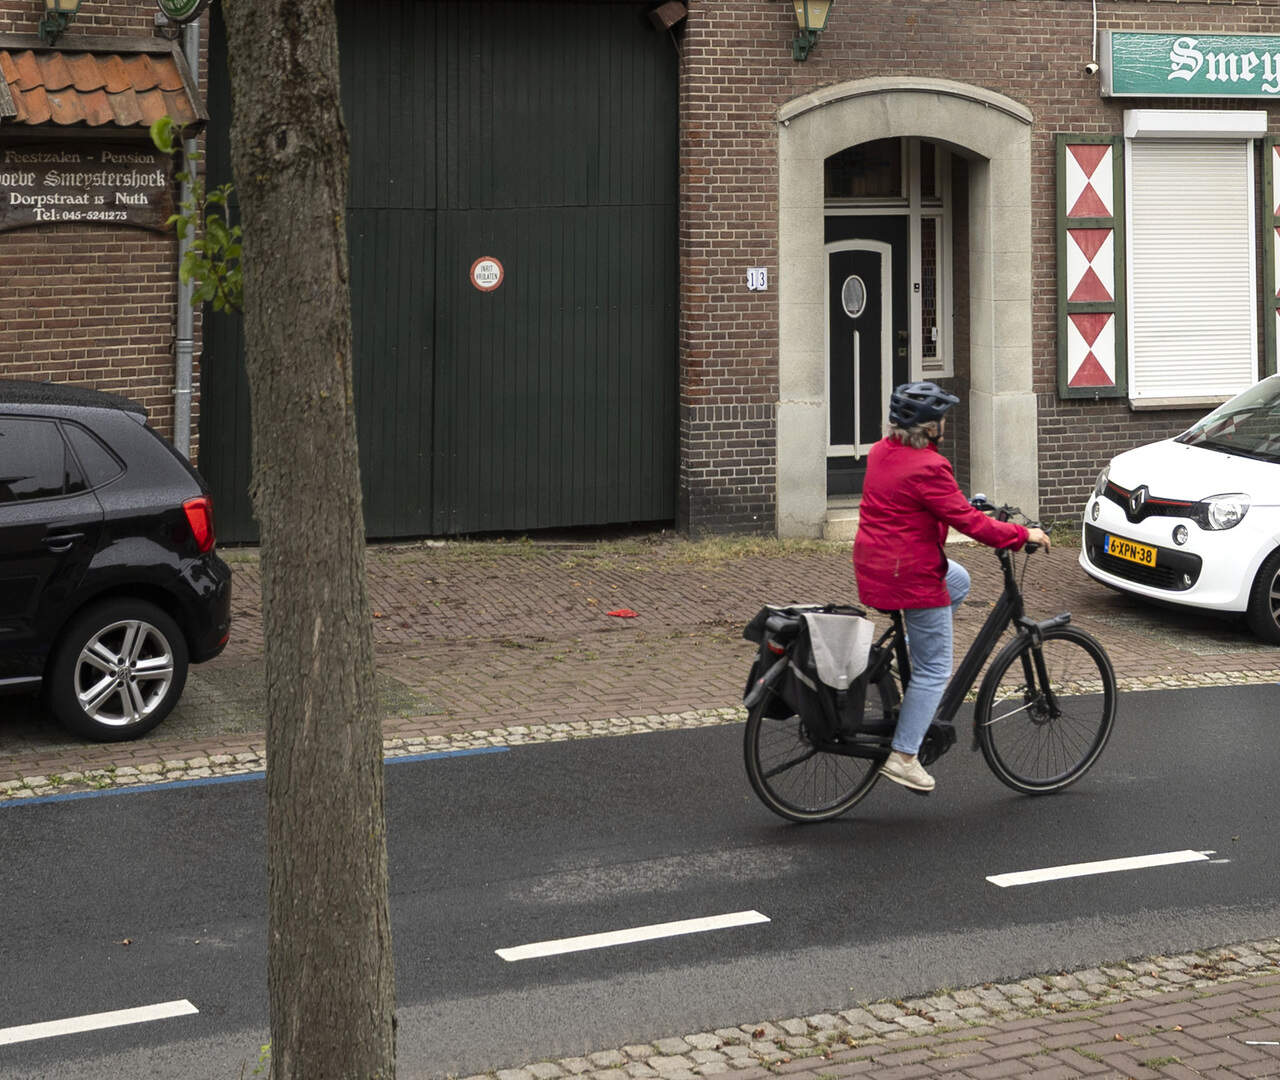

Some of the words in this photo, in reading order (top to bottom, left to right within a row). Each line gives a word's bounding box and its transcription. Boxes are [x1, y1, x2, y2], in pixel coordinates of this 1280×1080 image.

[5, 151, 80, 164] Feestzalen
[101, 151, 155, 164] Pension
[43, 169, 166, 190] Smeystershoek
[10, 192, 89, 208] Dorpstraat
[116, 192, 148, 205] Nuth
[33, 208, 60, 221] Tel:
[750, 271, 765, 287] 13
[1111, 540, 1153, 564] 6-XPN-38
